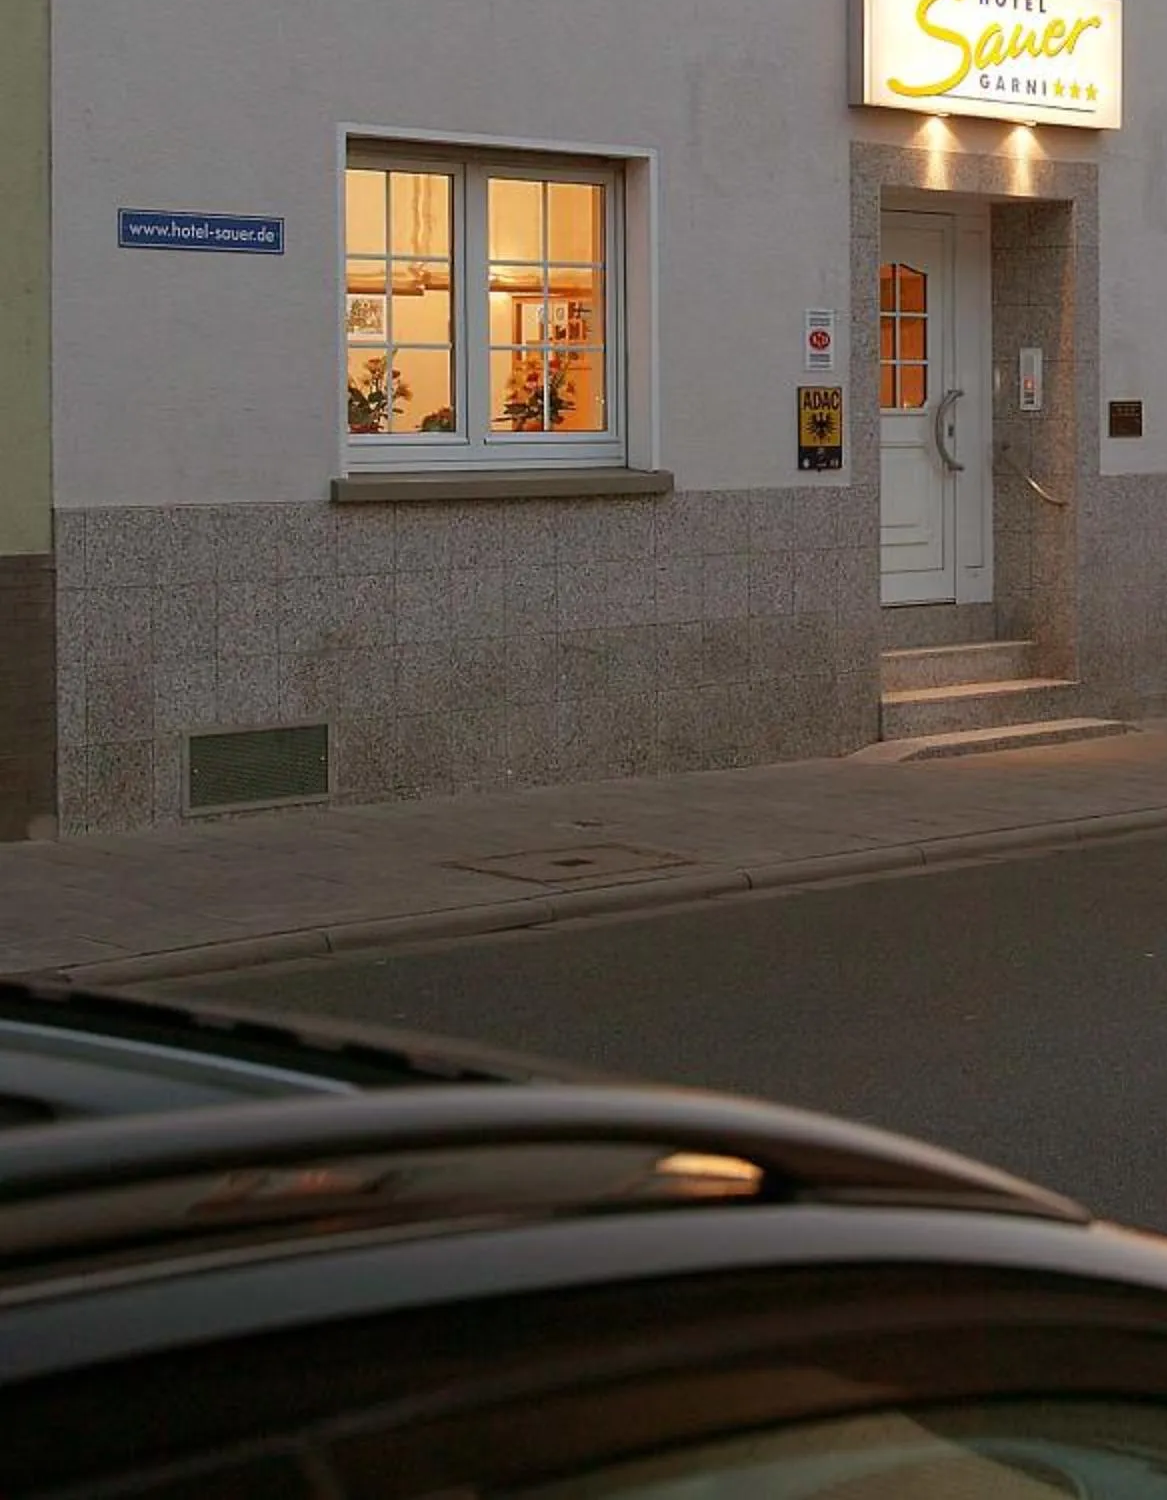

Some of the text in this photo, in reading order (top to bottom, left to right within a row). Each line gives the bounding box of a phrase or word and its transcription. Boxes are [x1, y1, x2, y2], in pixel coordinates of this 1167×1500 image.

[979, 74, 1047, 96] GARNI
[128, 220, 275, 243] www.hotel-sauer.de
[803, 391, 840, 411] ADAC
